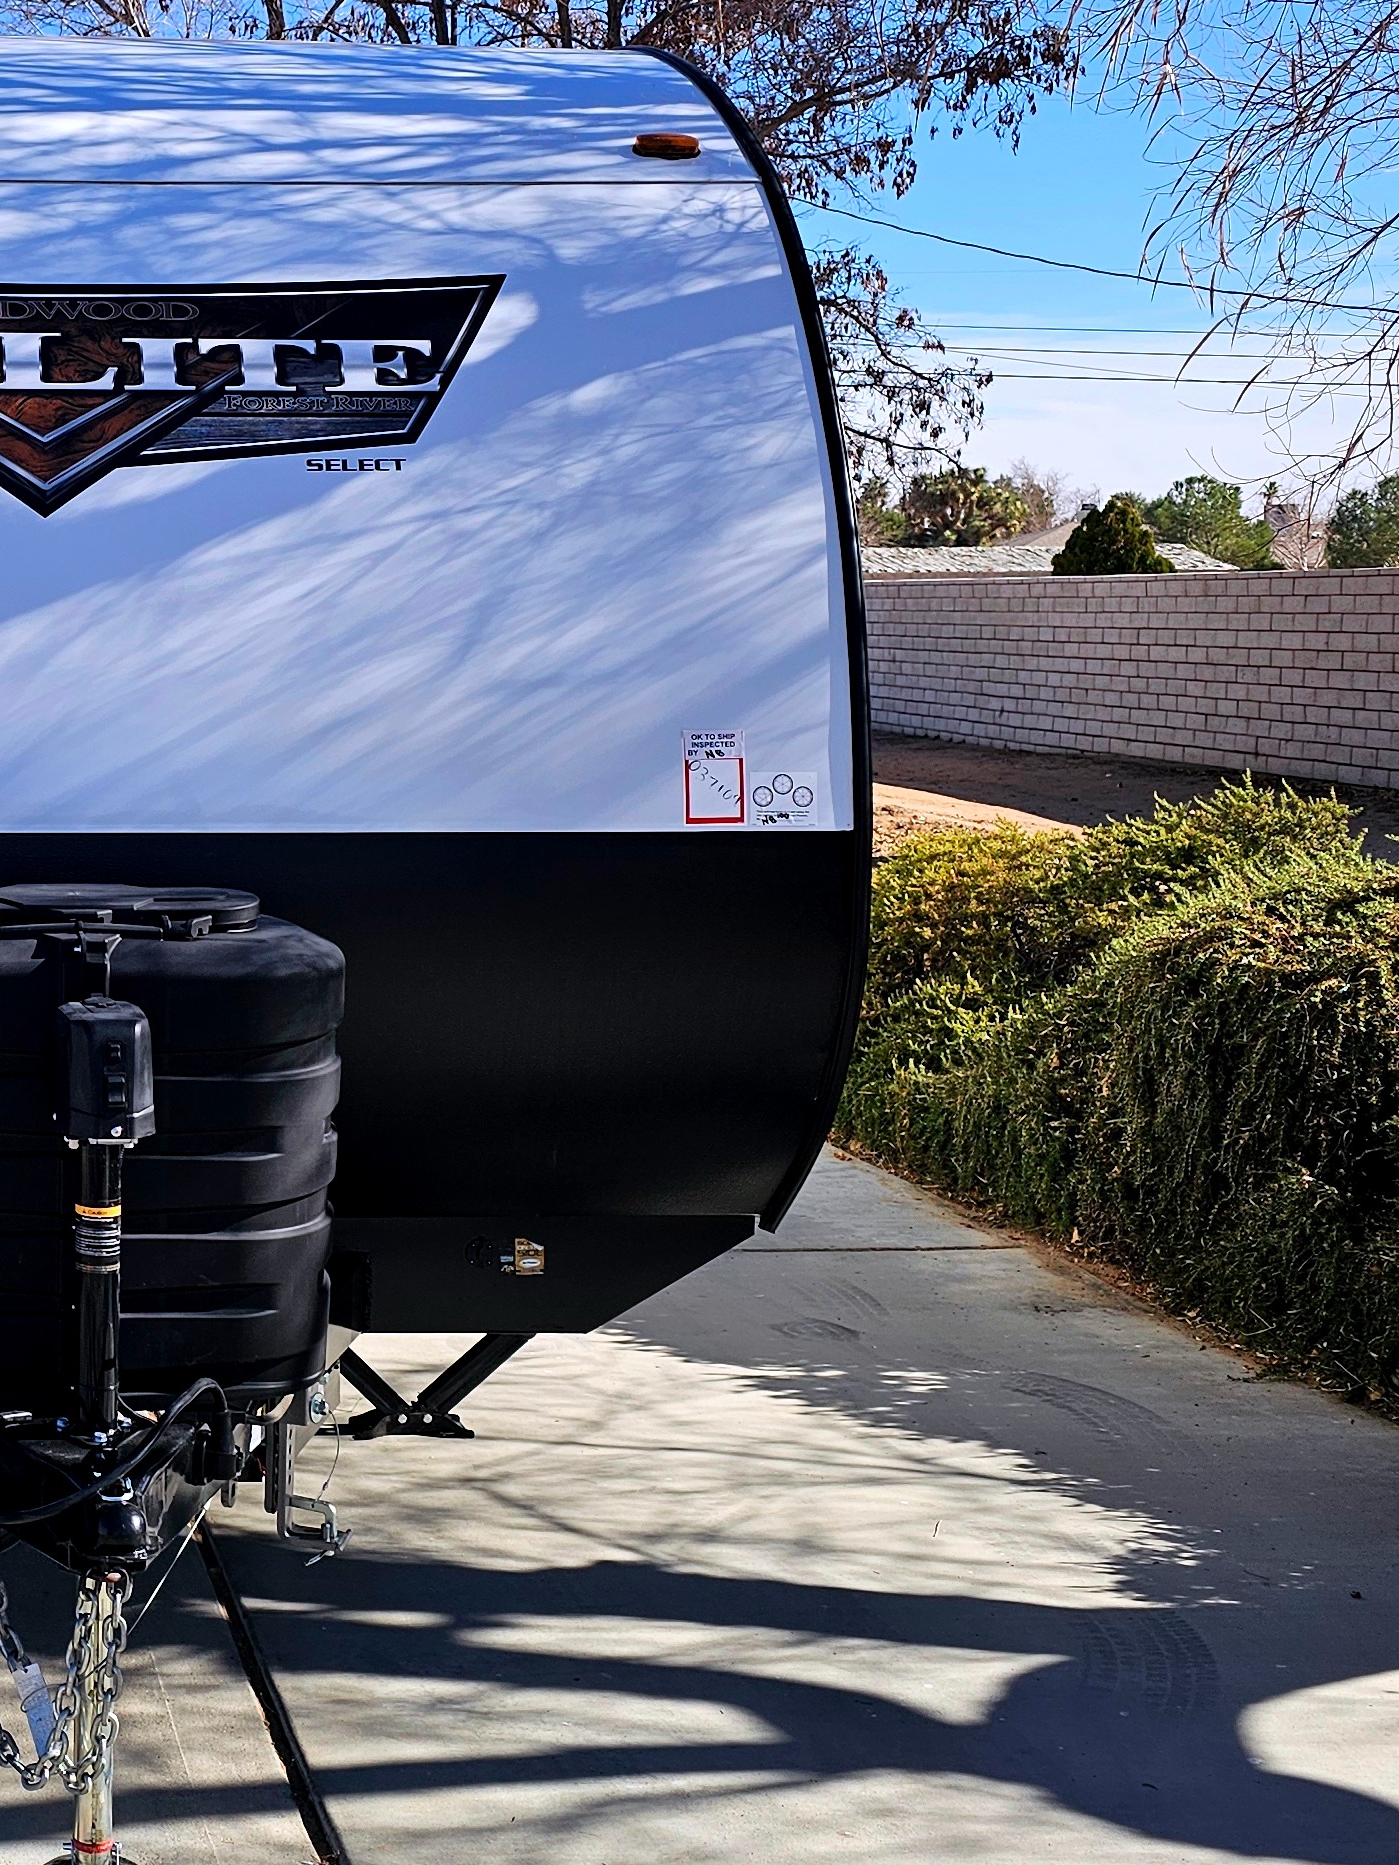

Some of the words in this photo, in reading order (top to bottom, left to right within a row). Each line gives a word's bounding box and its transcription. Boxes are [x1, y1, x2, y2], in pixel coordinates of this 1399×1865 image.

[223, 394, 327, 411] FOREST
[331, 394, 415, 411] RIVER
[305, 458, 407, 472] SELECT
[690, 733, 703, 741] OK
[704, 733, 716, 741] TO
[691, 740, 736, 748] INSPECTED
